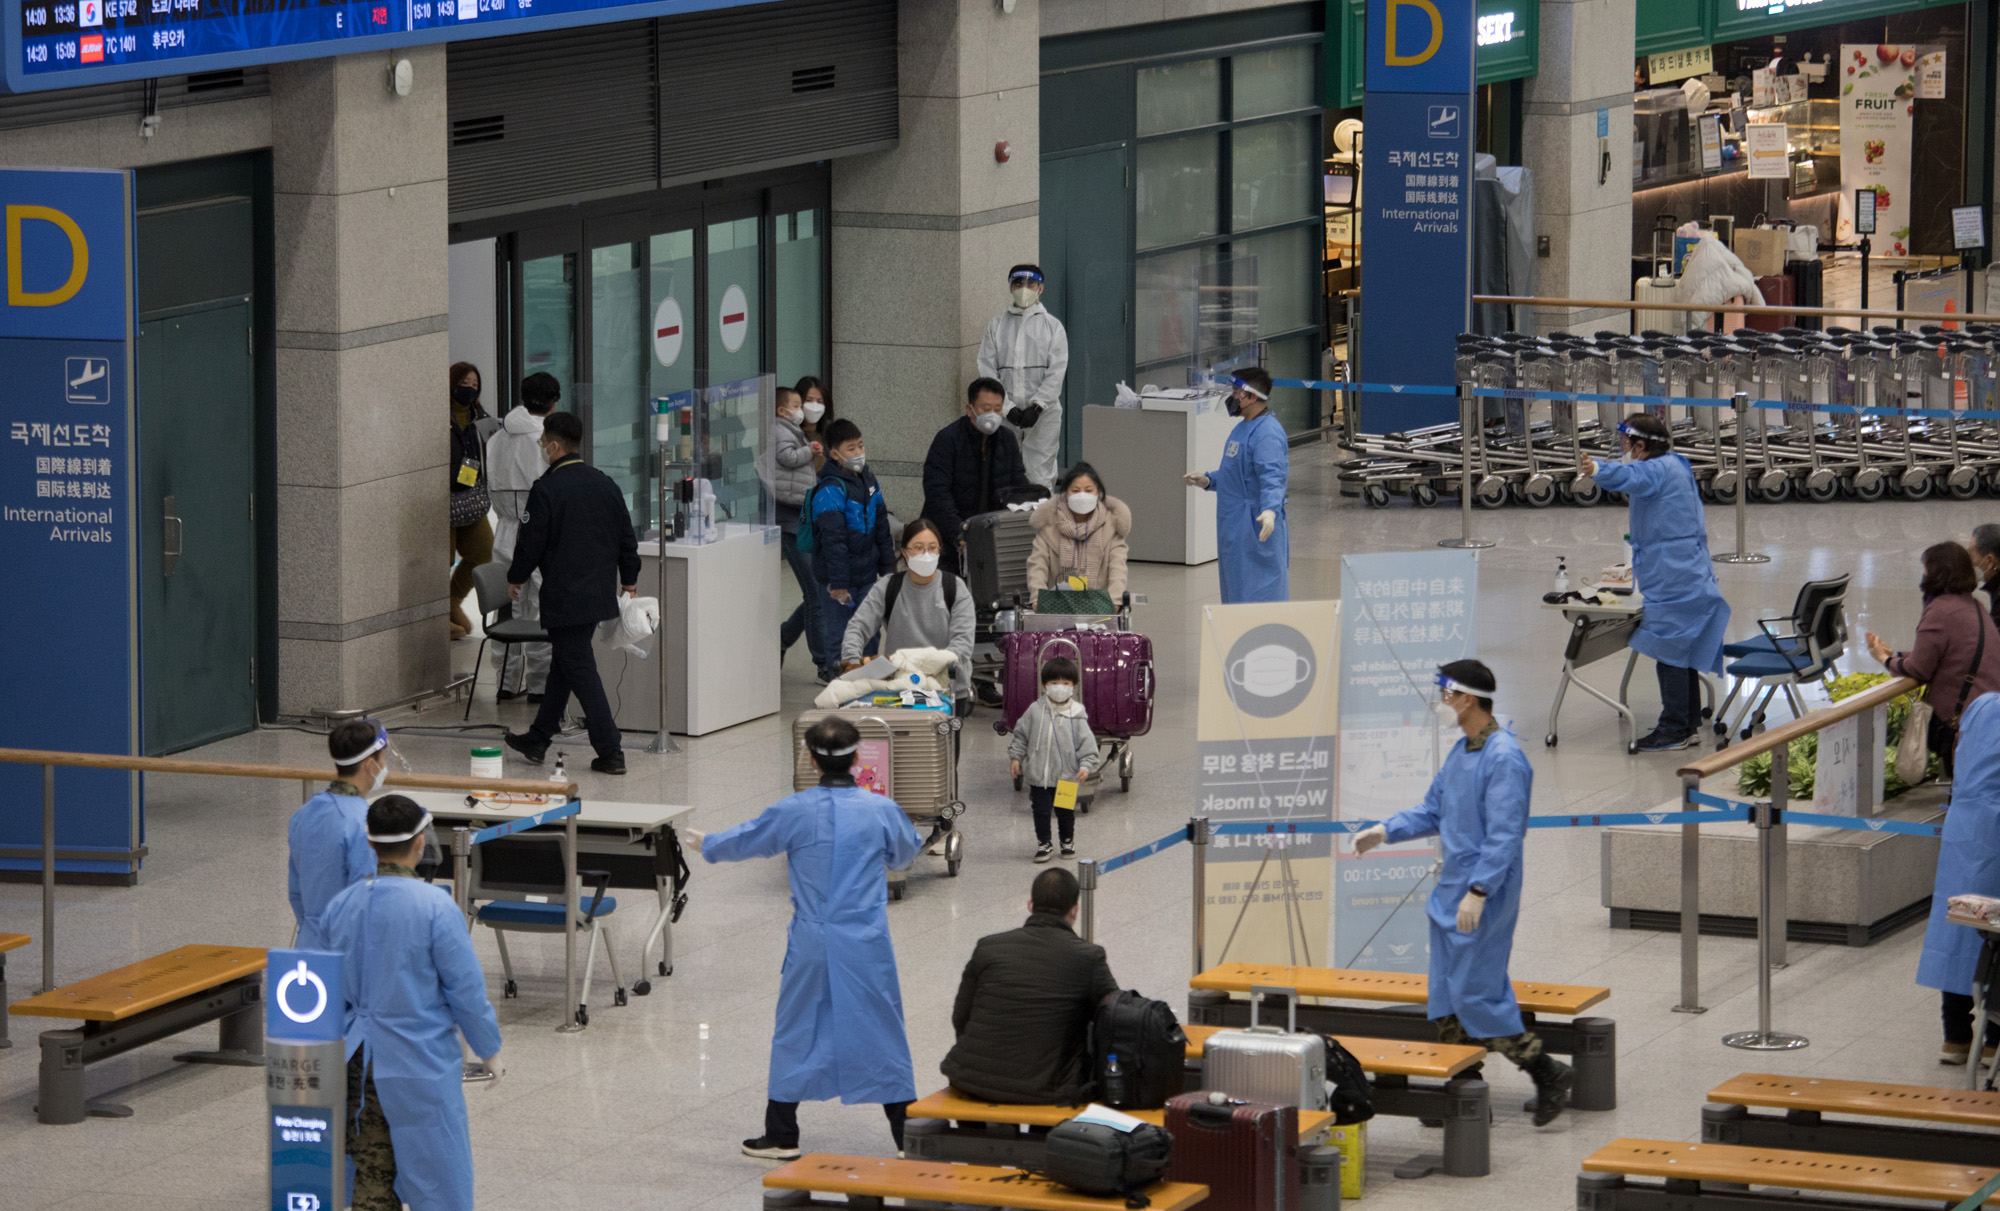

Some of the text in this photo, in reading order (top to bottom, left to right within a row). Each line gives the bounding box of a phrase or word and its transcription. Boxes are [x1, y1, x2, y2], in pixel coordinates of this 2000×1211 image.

[25, 5, 75, 27] 14:00 13:36
[105, 0, 137, 19] KE 5742
[372, 6, 388, 25] 지연
[413, 3, 431, 20] 15:10
[437, 1, 455, 18] 14:50
[336, 11, 343, 29] E
[153, 29, 185, 49] 후쿠오카
[1385, 0, 1444, 66] D
[26, 41, 76, 63] 14:20 15:09
[106, 35, 136, 54] 7C 1401
[1855, 99, 1897, 110] FRUIT
[1388, 151, 1459, 168] 국제선도착
[1405, 174, 1459, 188] 国際線到着
[1405, 191, 1458, 204] 国际线到达
[1382, 208, 1459, 221] International
[1414, 221, 1458, 234] Arrivals
[6, 204, 89, 307] D
[1503, 390, 1536, 399] SECURITY
[1787, 402, 1821, 411] SECURITY
[11, 422, 112, 448] 국제선도착
[36, 457, 112, 476] 国際線到着
[36, 480, 112, 499] 国际线到达
[4, 506, 113, 525] International
[49, 526, 112, 544] Arrivals
